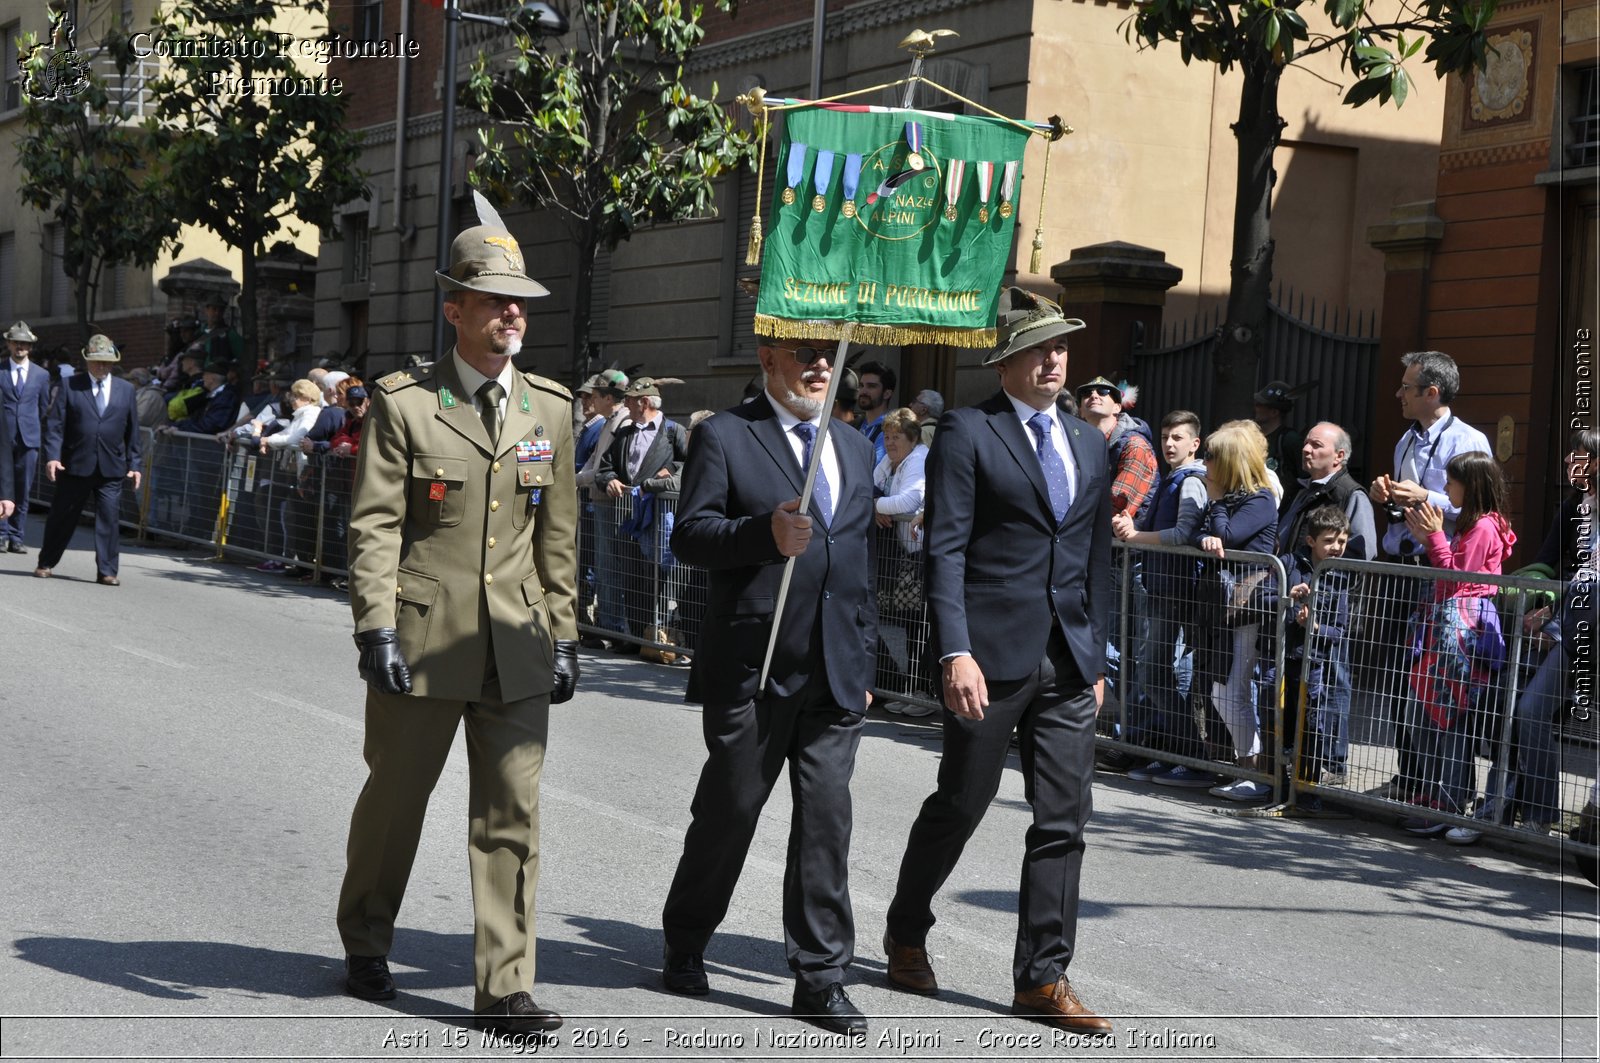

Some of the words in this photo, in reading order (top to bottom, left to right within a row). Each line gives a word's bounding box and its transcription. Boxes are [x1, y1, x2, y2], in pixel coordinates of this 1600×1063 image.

[872, 211, 915, 225] ALPINI
[784, 276, 850, 305] SEZIONE
[857, 281, 876, 305] DI
[885, 284, 983, 312] PORDENONE
